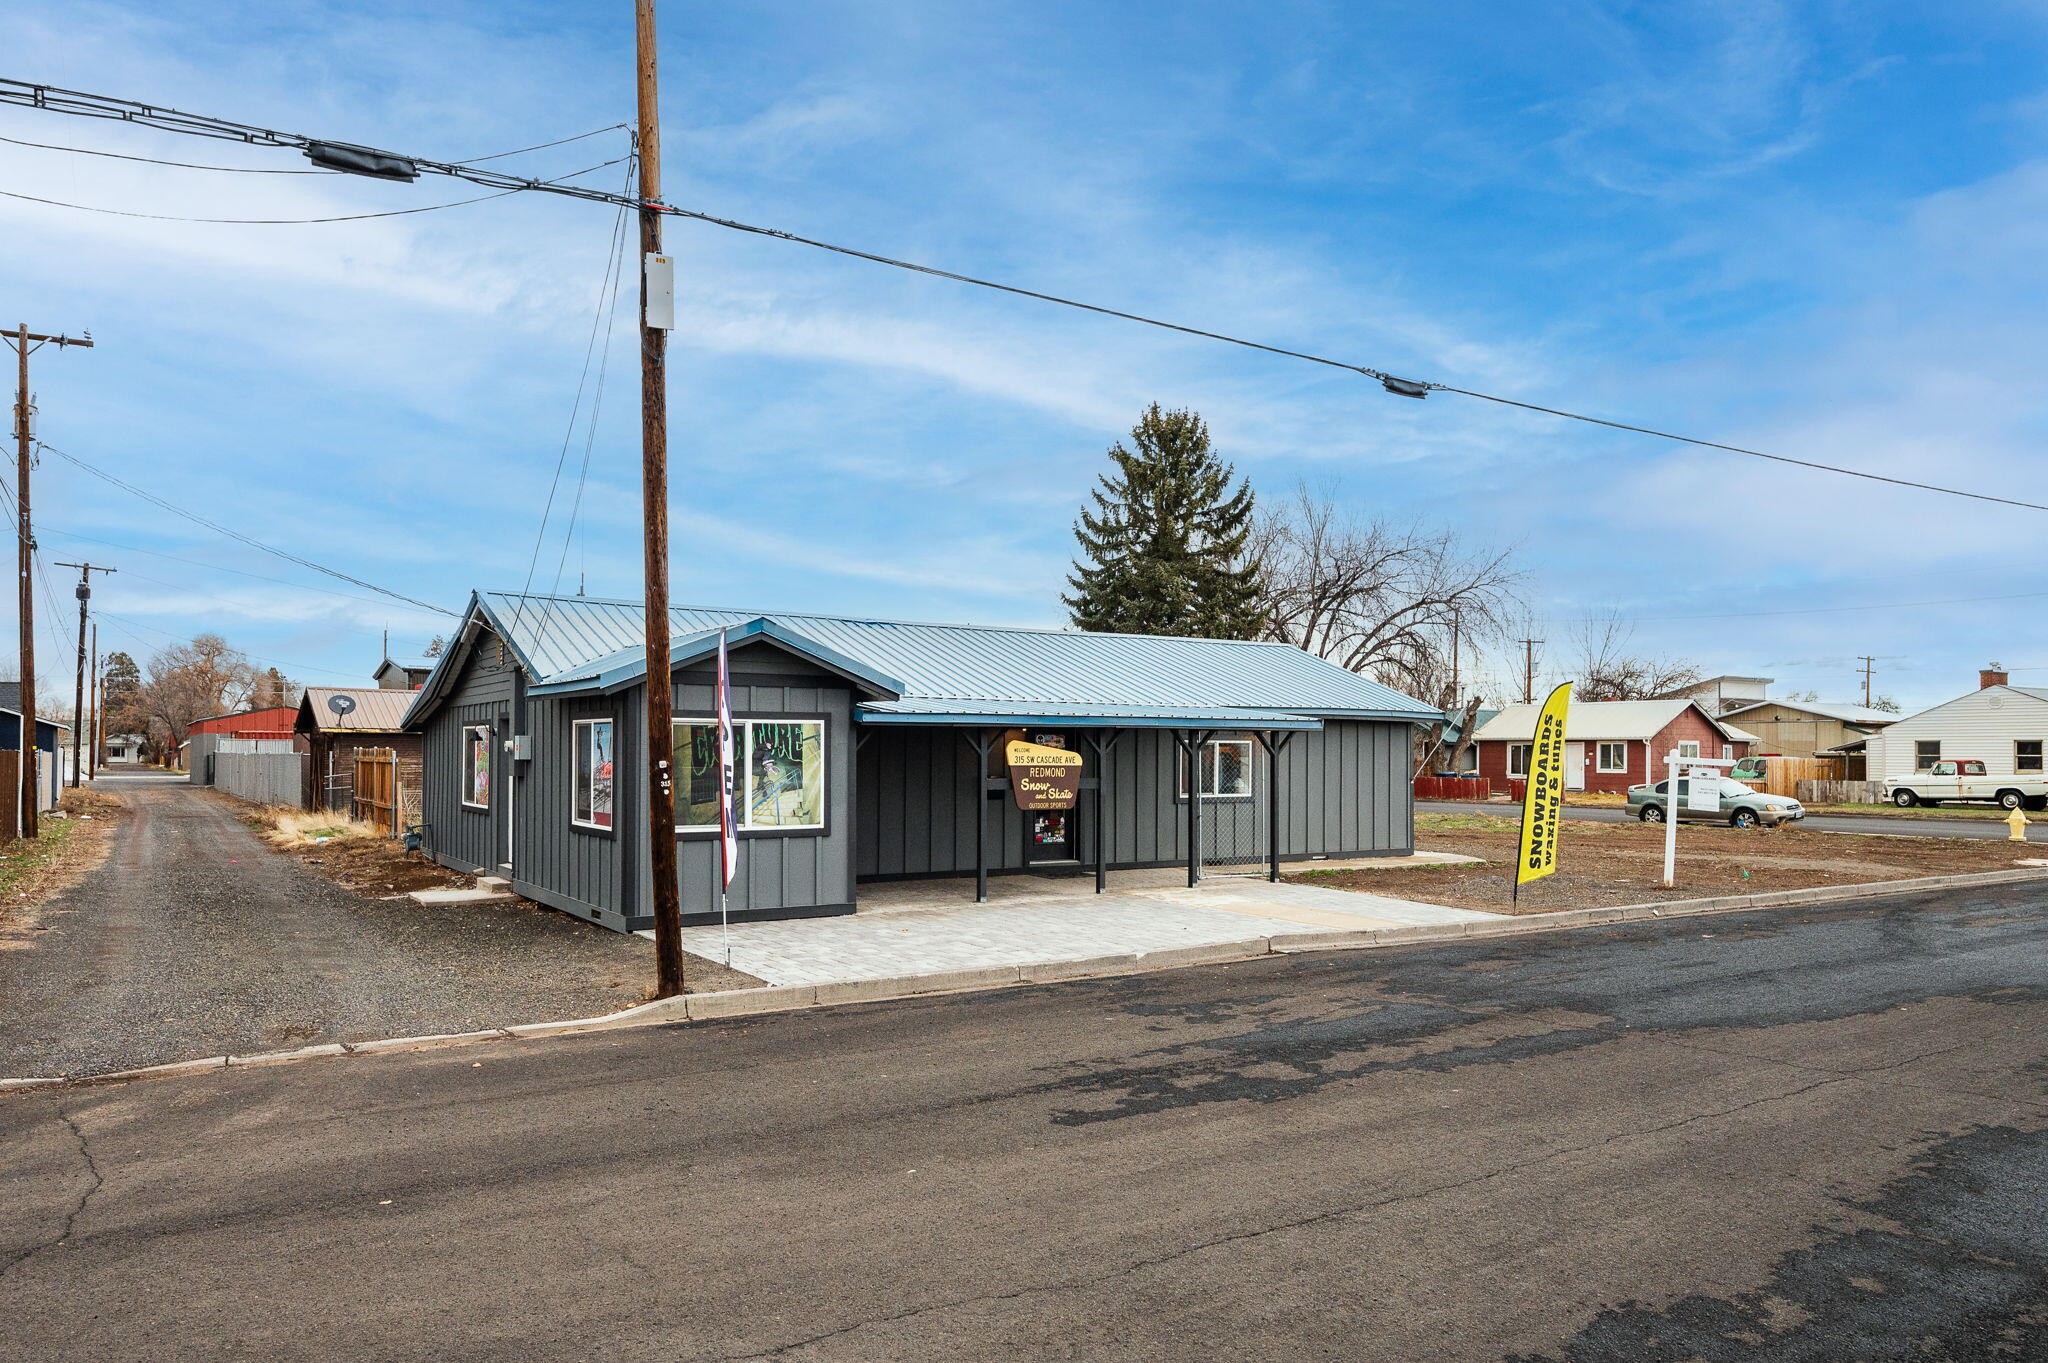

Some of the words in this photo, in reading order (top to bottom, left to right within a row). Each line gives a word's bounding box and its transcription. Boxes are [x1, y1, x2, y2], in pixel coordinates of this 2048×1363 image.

[1551, 719, 1562, 771] tunes
[1014, 755, 1025, 764] 315
[1026, 755, 1036, 764] SW
[1036, 755, 1063, 764] CASCADE
[1064, 755, 1076, 764] AVE
[1029, 767, 1066, 778] REDMOND
[1020, 778, 1050, 790] Snow
[1548, 777, 1558, 791] &
[1048, 788, 1073, 799] Skate
[1529, 713, 1553, 869] SNOWBOARDS
[1545, 795, 1559, 866] waxing
